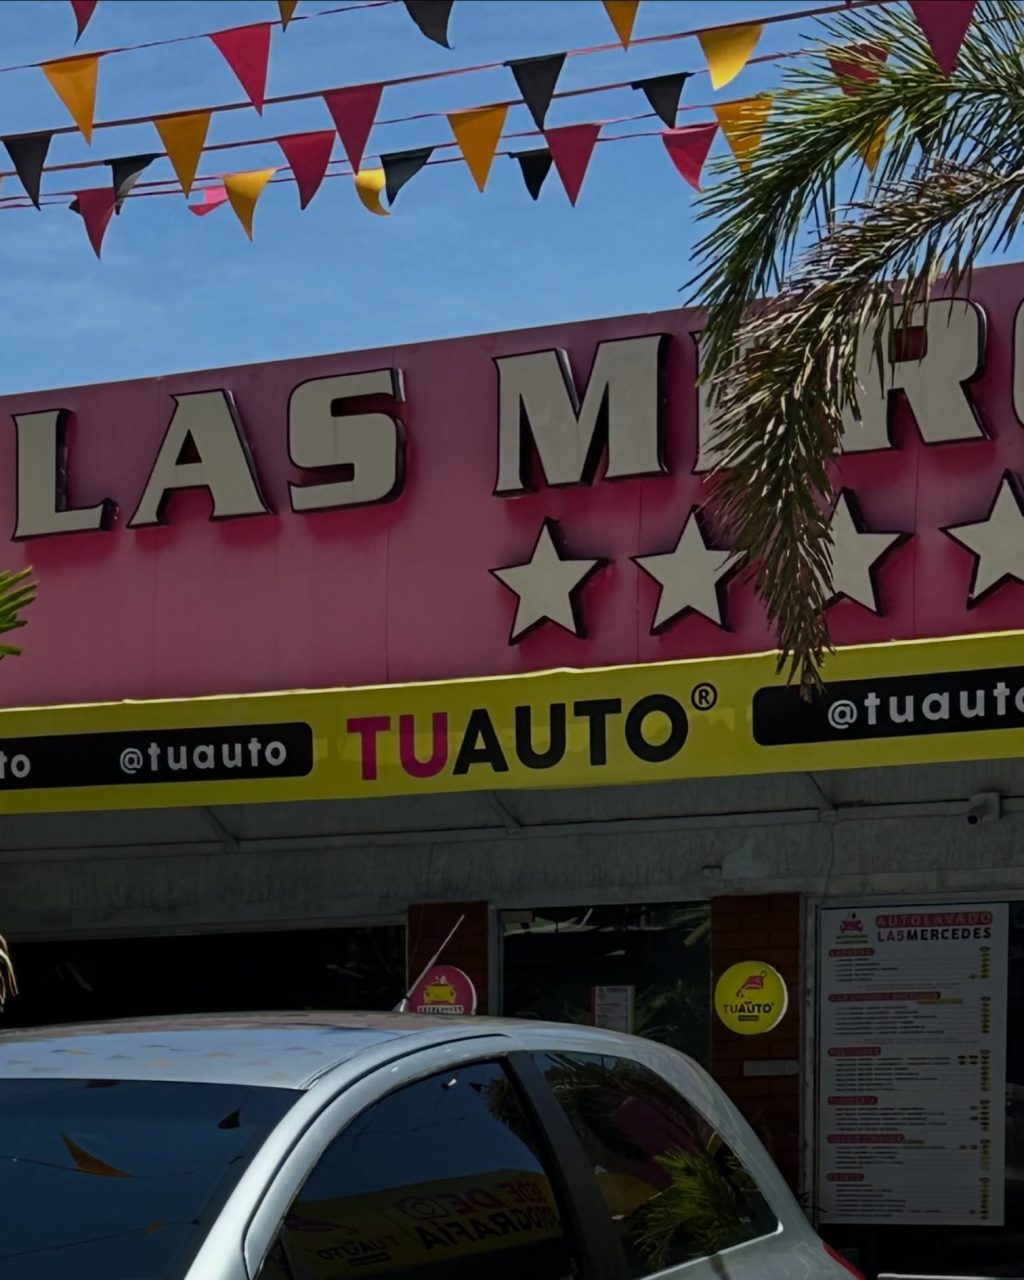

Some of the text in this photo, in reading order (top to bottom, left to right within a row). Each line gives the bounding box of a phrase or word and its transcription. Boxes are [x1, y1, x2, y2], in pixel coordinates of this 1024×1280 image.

[12, 298, 1024, 542] LAS MR
[119, 735, 288, 775] @tuauto
